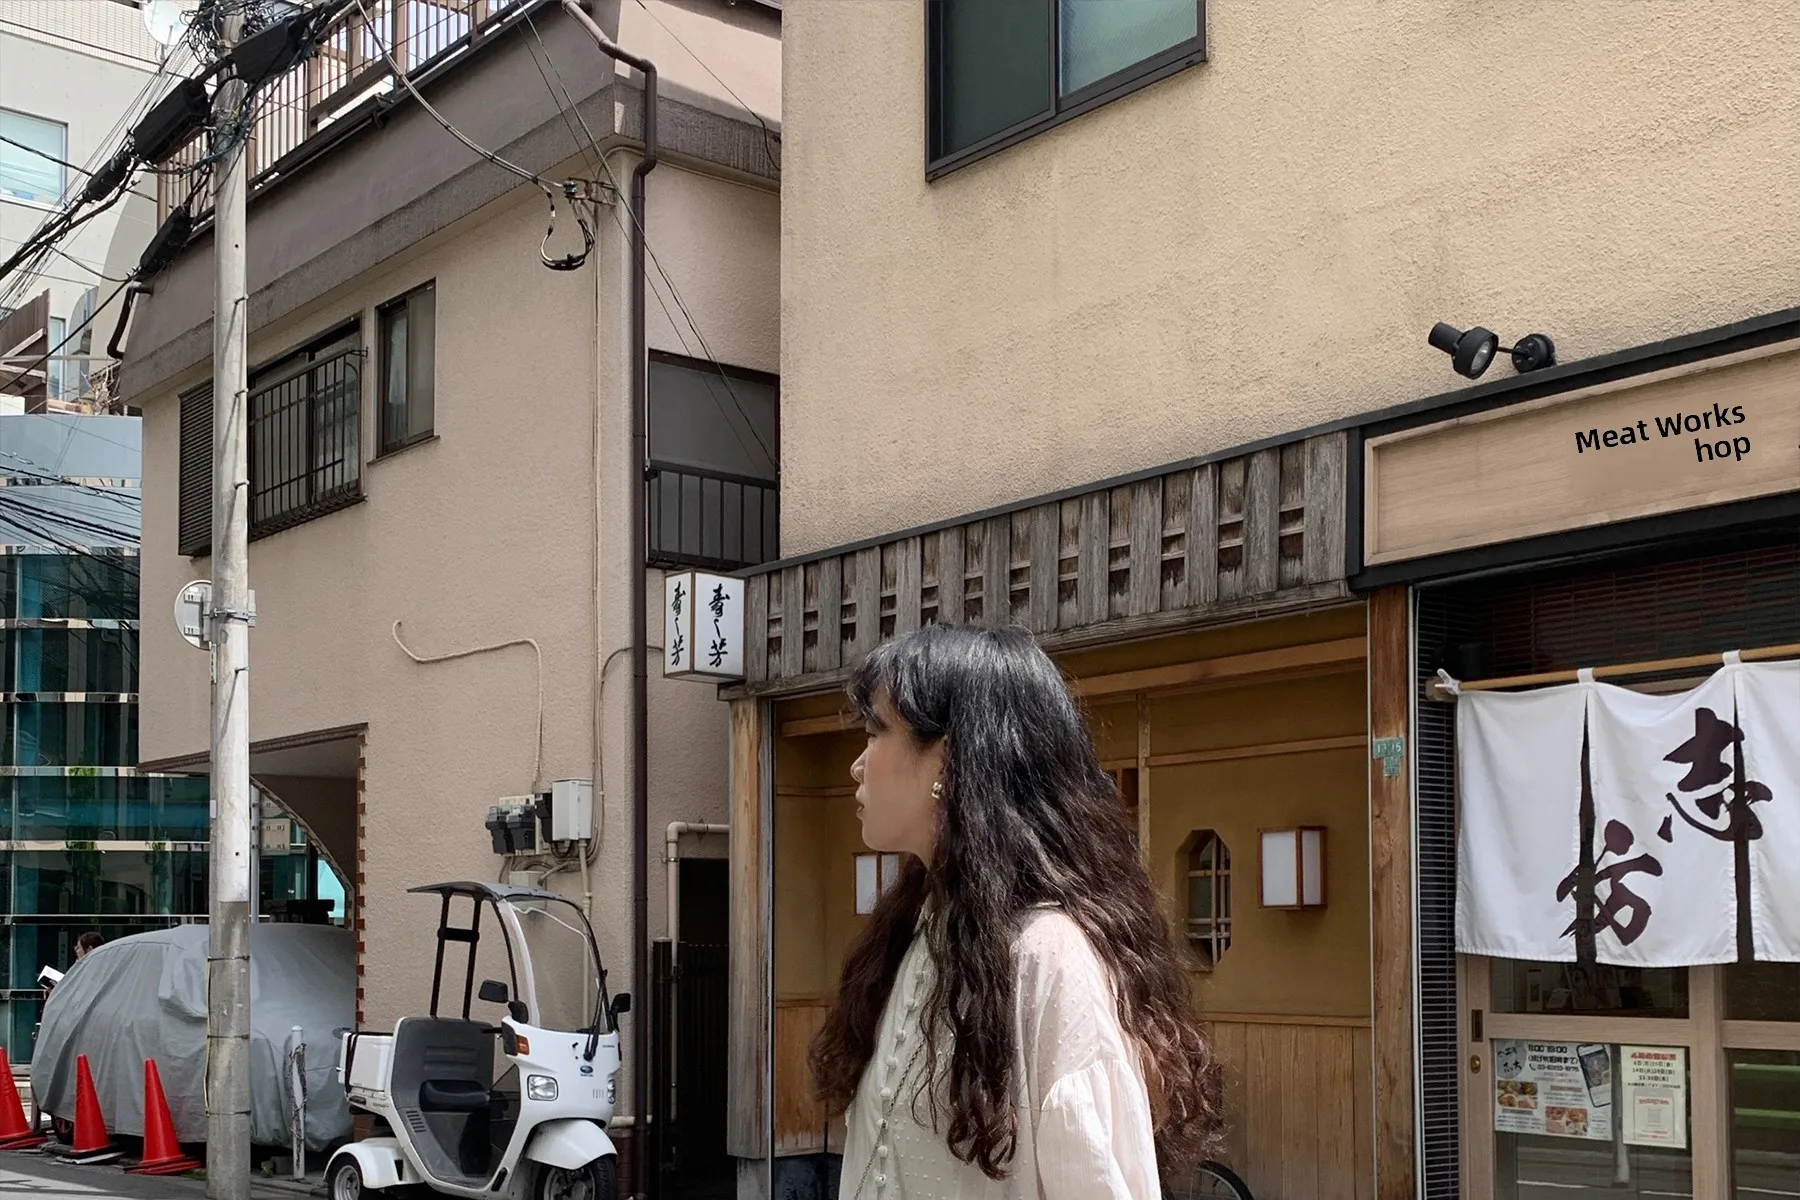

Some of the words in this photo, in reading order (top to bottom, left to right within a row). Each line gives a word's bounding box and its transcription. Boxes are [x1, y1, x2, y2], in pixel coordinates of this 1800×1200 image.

[1575, 420, 1650, 454] Meat
[1654, 402, 1746, 438] Works
[1694, 436, 1751, 463] hop
